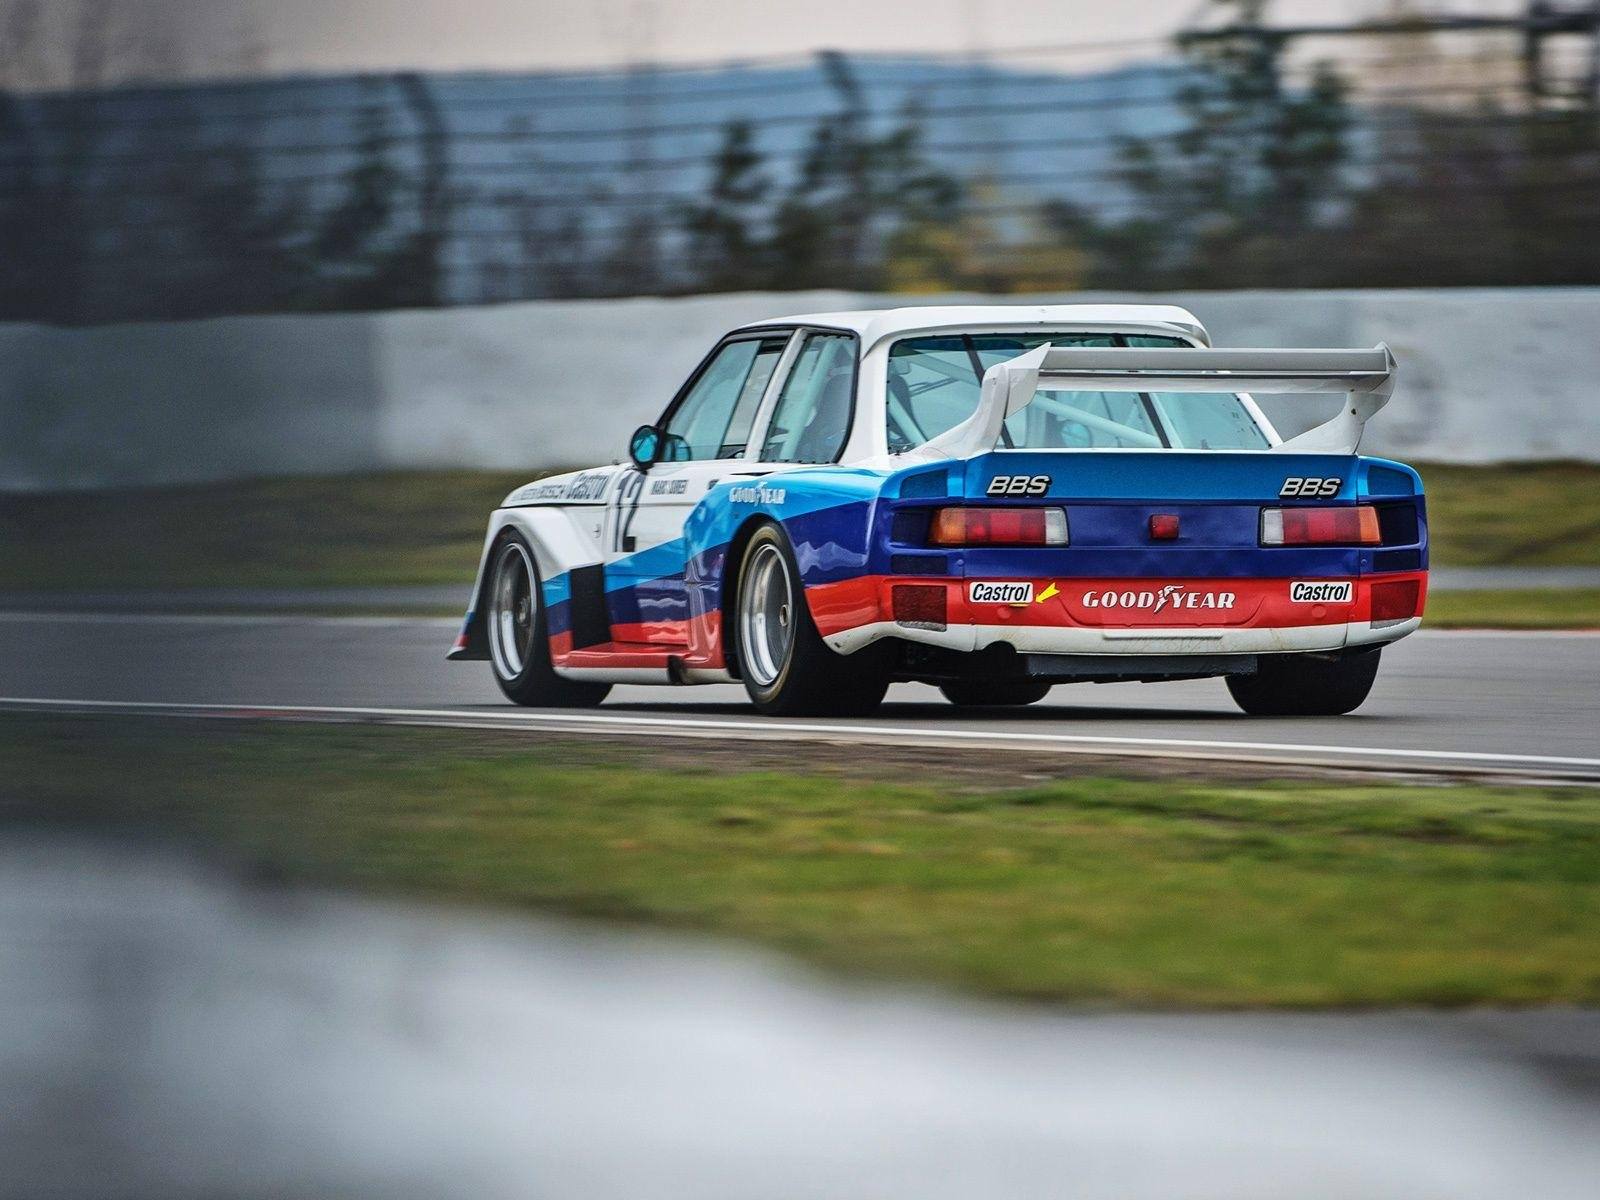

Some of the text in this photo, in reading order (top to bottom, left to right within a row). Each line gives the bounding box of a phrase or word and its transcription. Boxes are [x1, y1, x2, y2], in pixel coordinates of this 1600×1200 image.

[986, 475, 1051, 496] BBS
[1280, 477, 1342, 497] BBS
[614, 470, 646, 552] 12
[971, 582, 1031, 602] Castrol
[1292, 582, 1350, 602] Castrol
